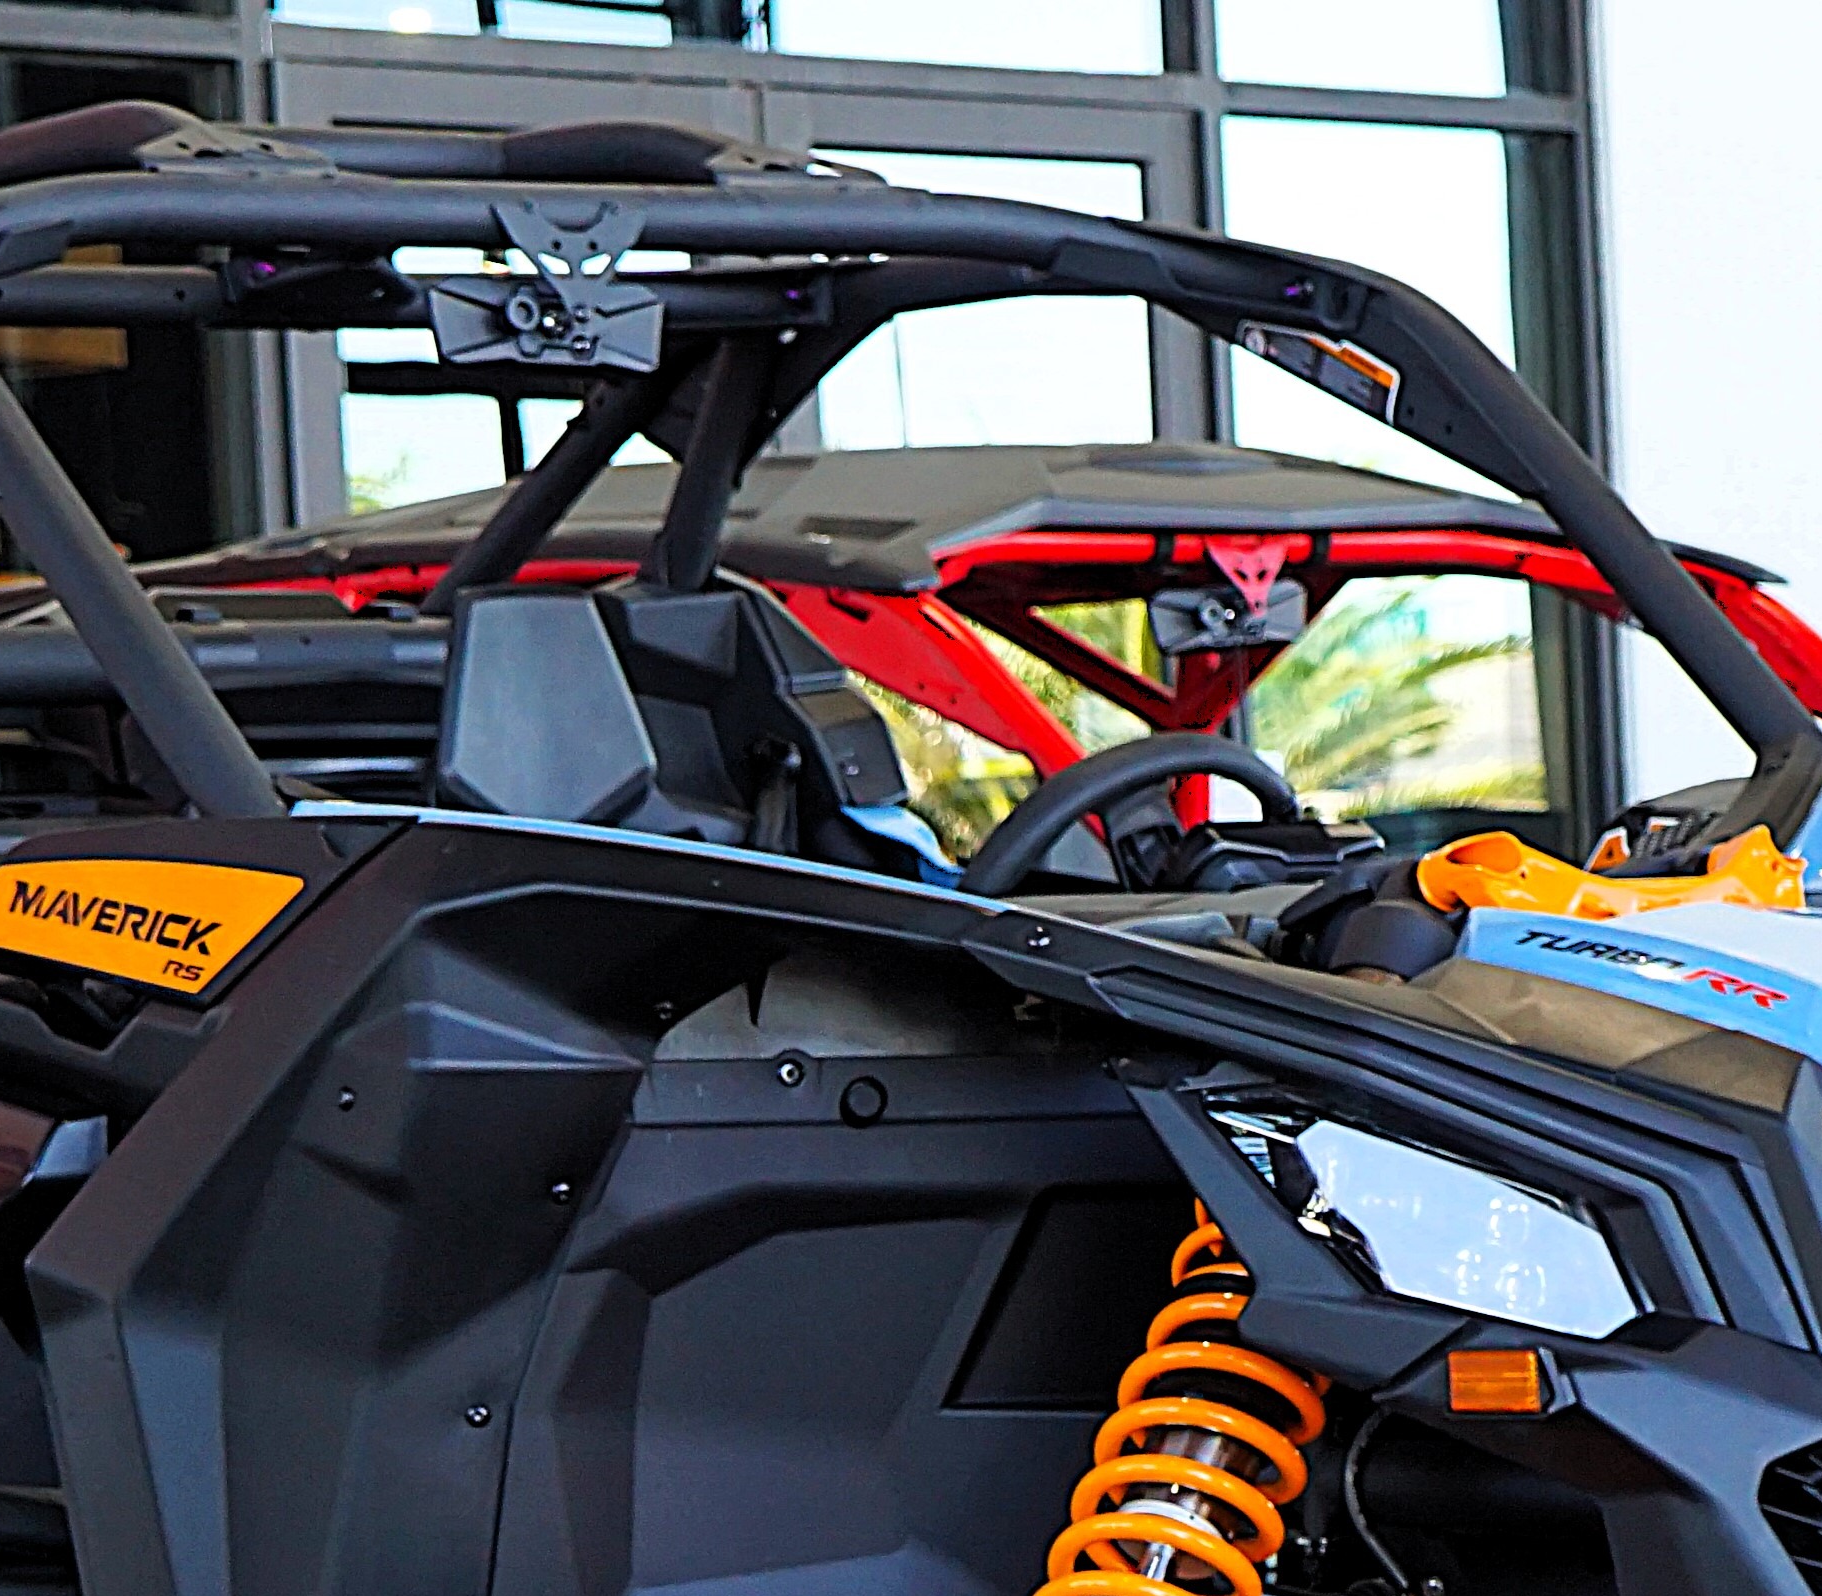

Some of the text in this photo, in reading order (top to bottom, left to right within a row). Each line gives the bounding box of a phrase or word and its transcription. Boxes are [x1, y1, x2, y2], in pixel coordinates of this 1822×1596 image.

[9, 880, 223, 957] MAVERICK
[162, 959, 205, 982] RS
[1682, 966, 1790, 1010] RR
